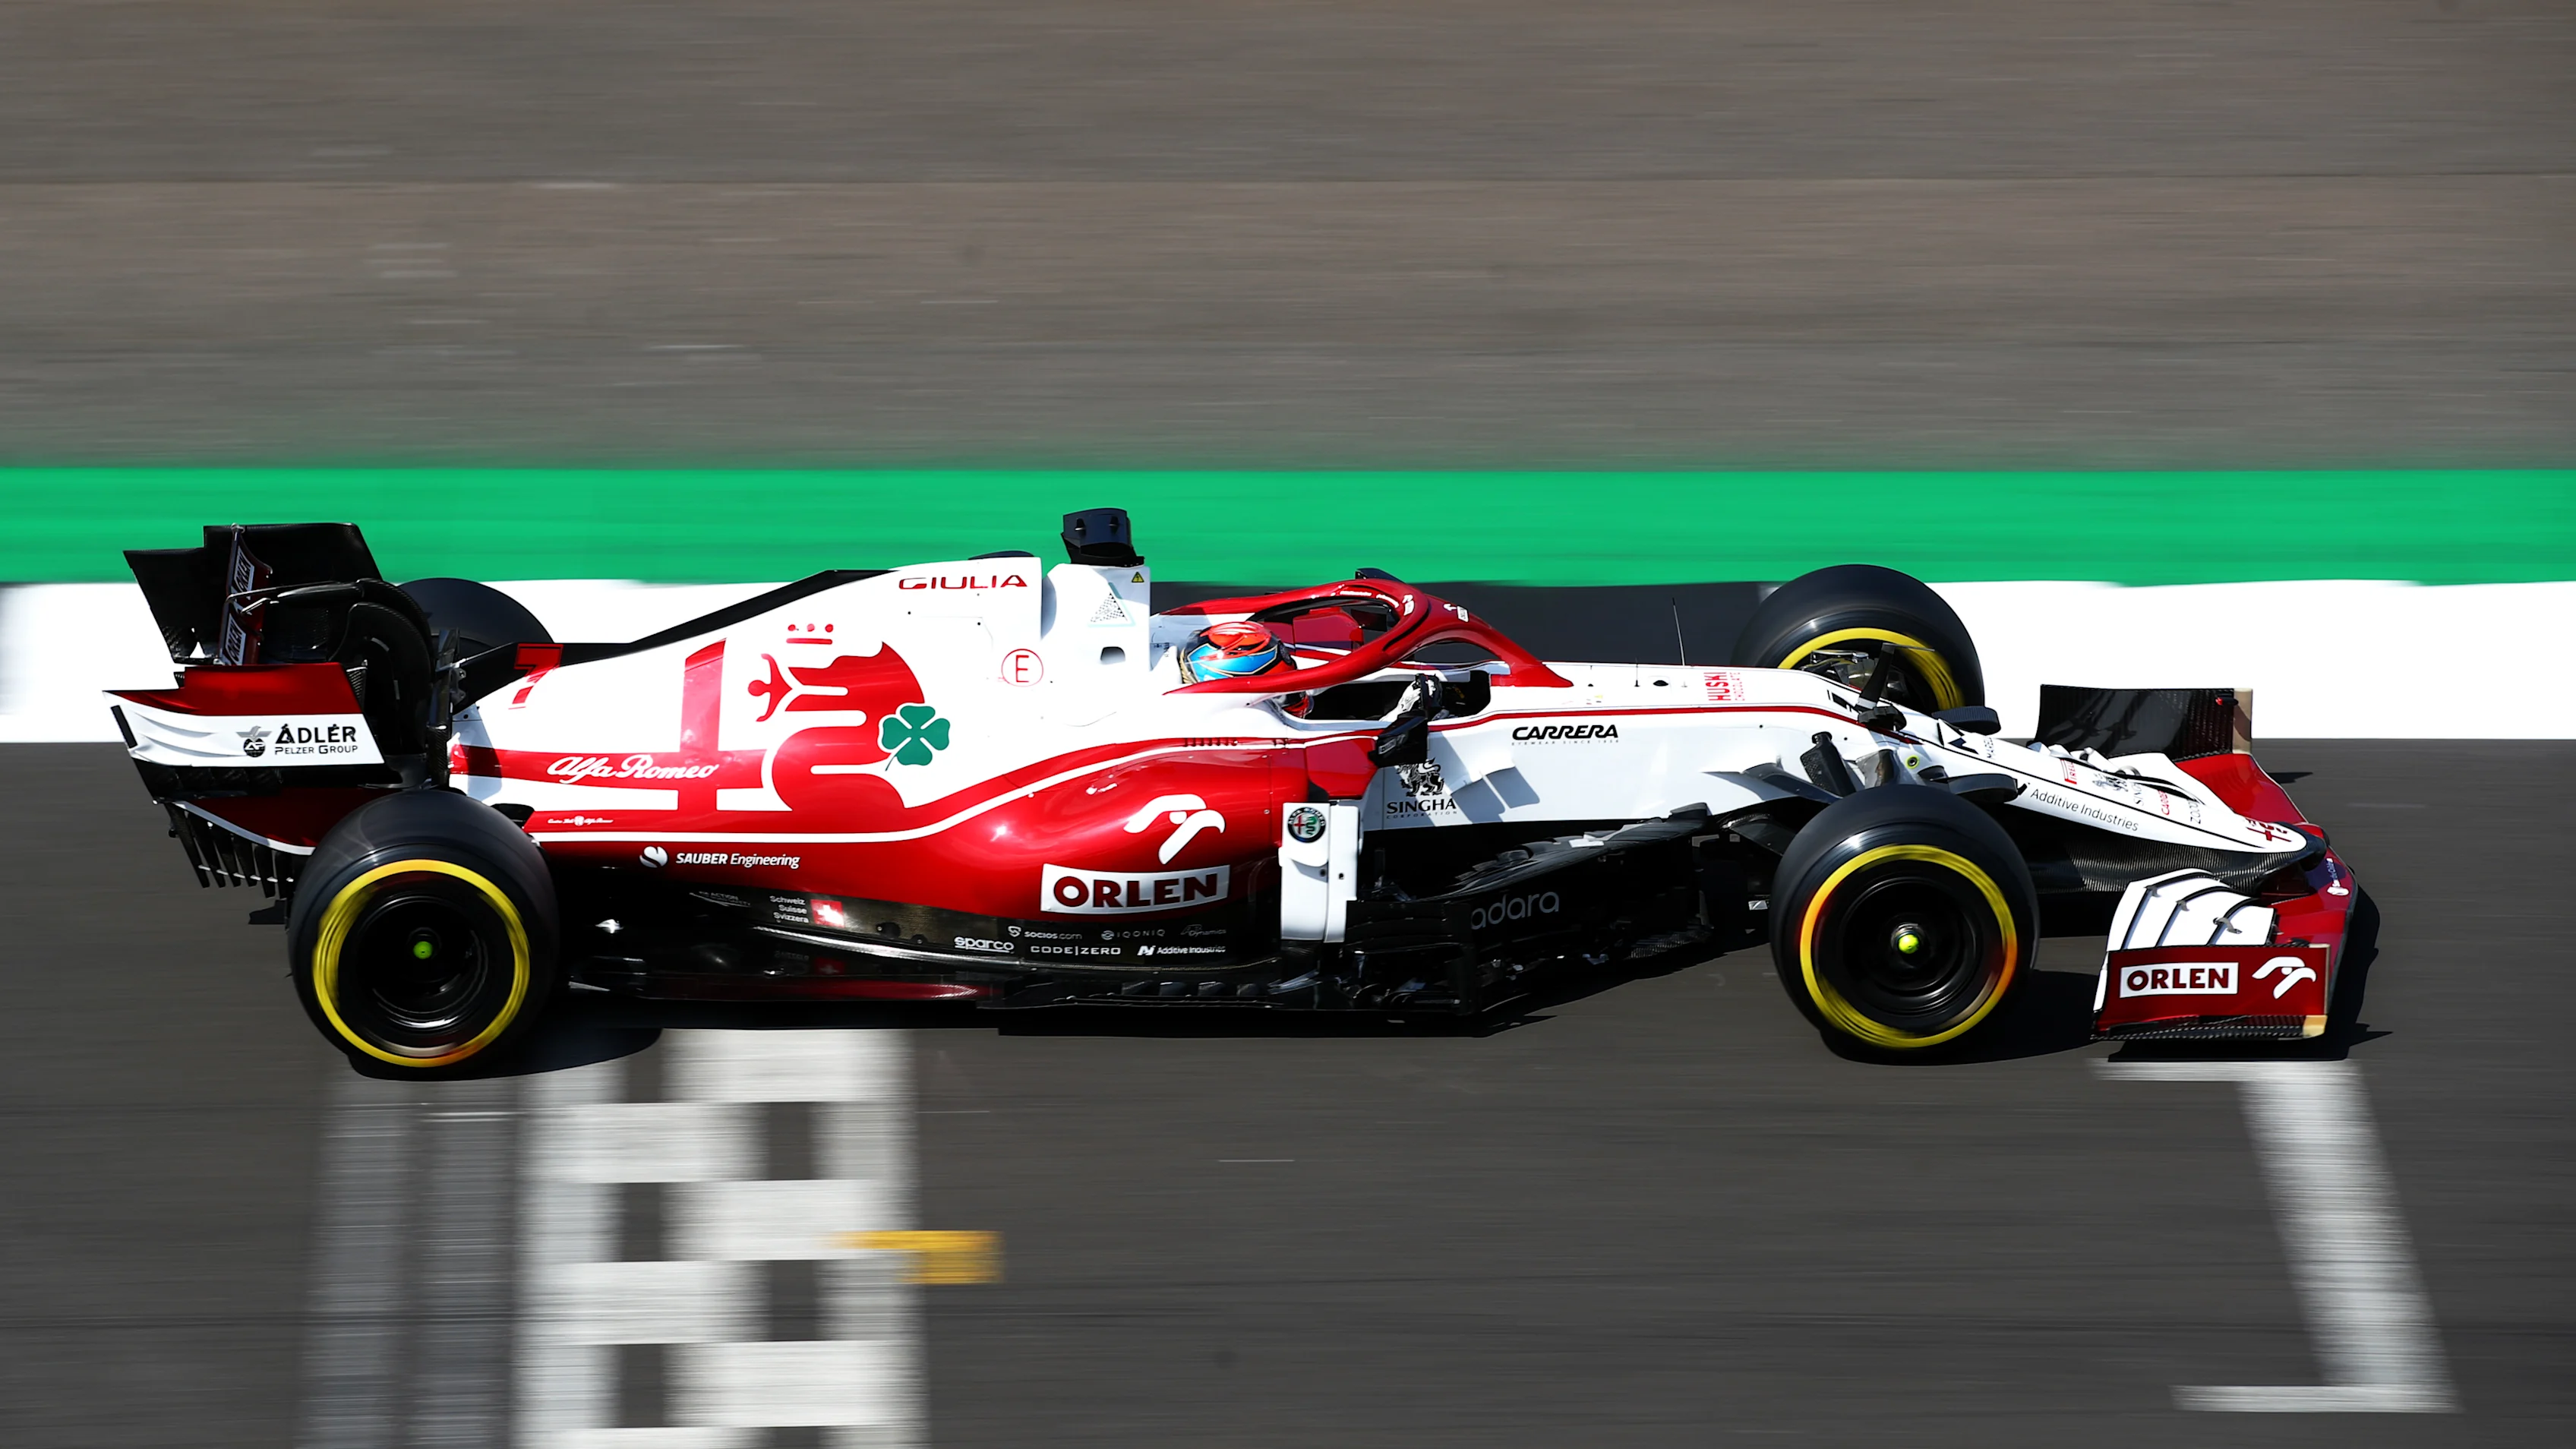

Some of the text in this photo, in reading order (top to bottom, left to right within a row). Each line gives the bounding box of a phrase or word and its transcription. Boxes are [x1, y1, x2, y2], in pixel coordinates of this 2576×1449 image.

[898, 575, 1028, 589] GIULIA
[508, 643, 564, 709] 7
[1703, 672, 1732, 701] HUSKI
[1512, 724, 1618, 740] CARRERA
[547, 754, 719, 784] Alfa Romeo
[1387, 798, 1457, 814] SINGHA
[2031, 788, 2139, 832] Additive Industries
[1387, 810, 1457, 819] CORPORATION
[676, 853, 800, 869] SAUBER Engineering
[1053, 873, 1217, 908] ORLEN
[769, 895, 806, 905] Schweiz
[778, 904, 807, 914] Suisse
[1471, 892, 1559, 930] adara
[773, 912, 810, 923] Svizzera
[1024, 931, 1083, 940] socios.com
[1117, 929, 1166, 938] IQONIQ
[954, 936, 1015, 950] sparco
[2127, 968, 2230, 992] ORLEN
